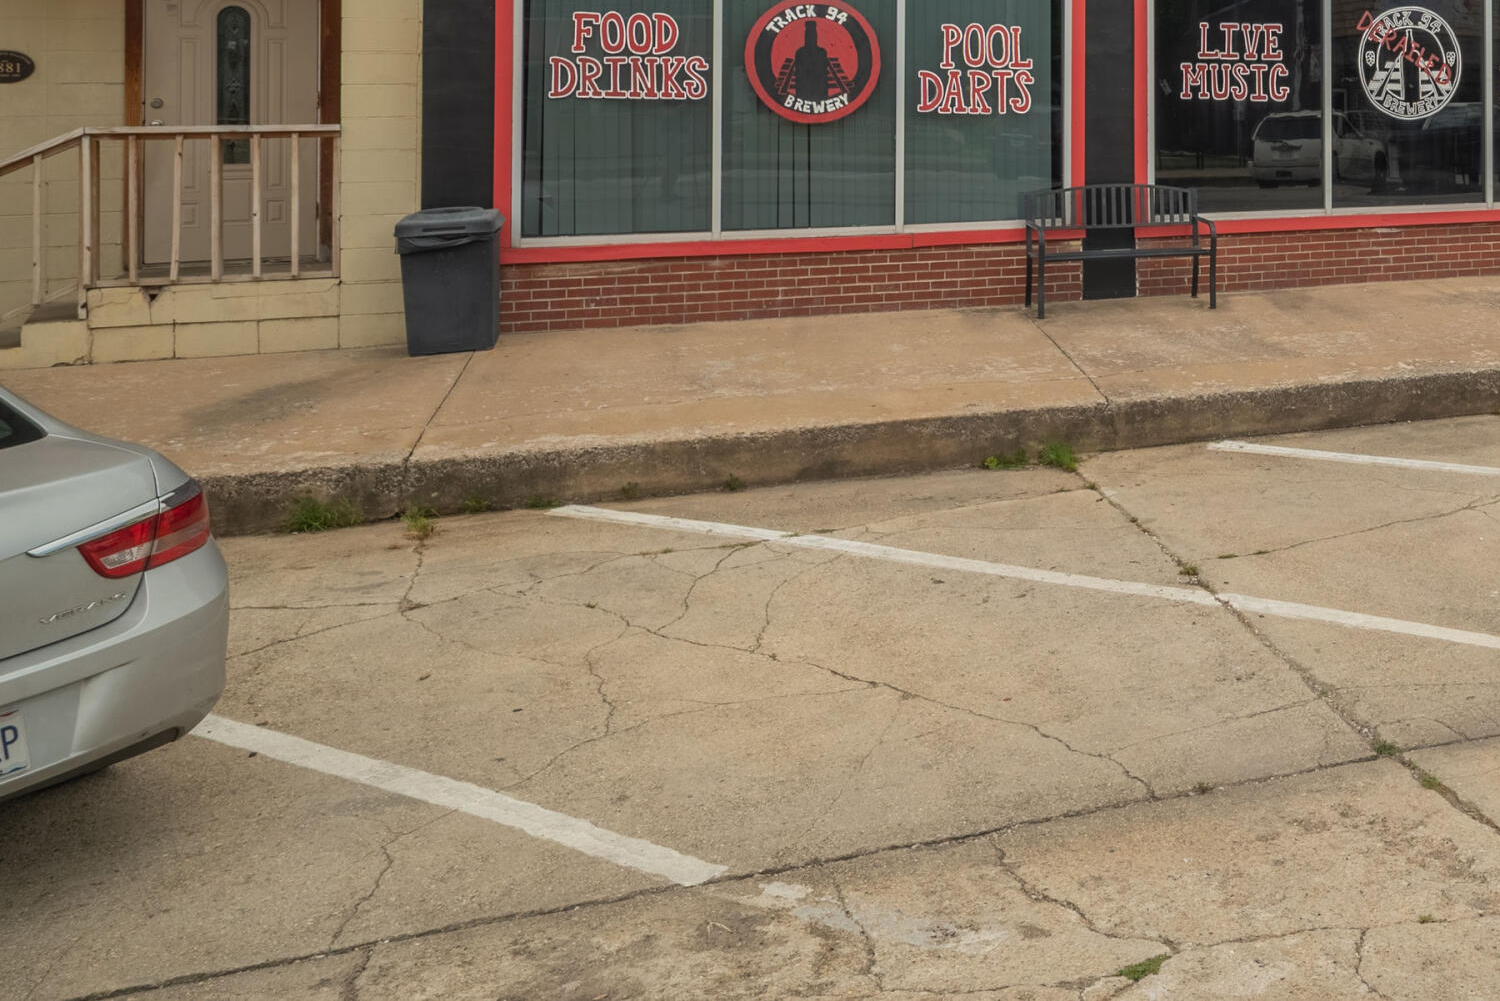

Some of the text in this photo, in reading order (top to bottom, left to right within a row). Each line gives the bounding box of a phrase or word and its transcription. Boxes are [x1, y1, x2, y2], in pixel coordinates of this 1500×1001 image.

[571, 11, 679, 55] FOOD
[765, 4, 849, 34] TRACK 94
[1368, 11, 1443, 42] TRACK 94
[940, 23, 1033, 69] POOL
[1198, 21, 1283, 61] LIVE
[1356, 10, 1452, 85] DERAILED
[548, 56, 709, 100] DRINKS
[917, 69, 1035, 115] DARTS
[1180, 62, 1290, 102] MUSIC
[784, 92, 850, 115] BREWERY
[1382, 94, 1442, 116] BREWERY
[0, 725, 19, 763] P
